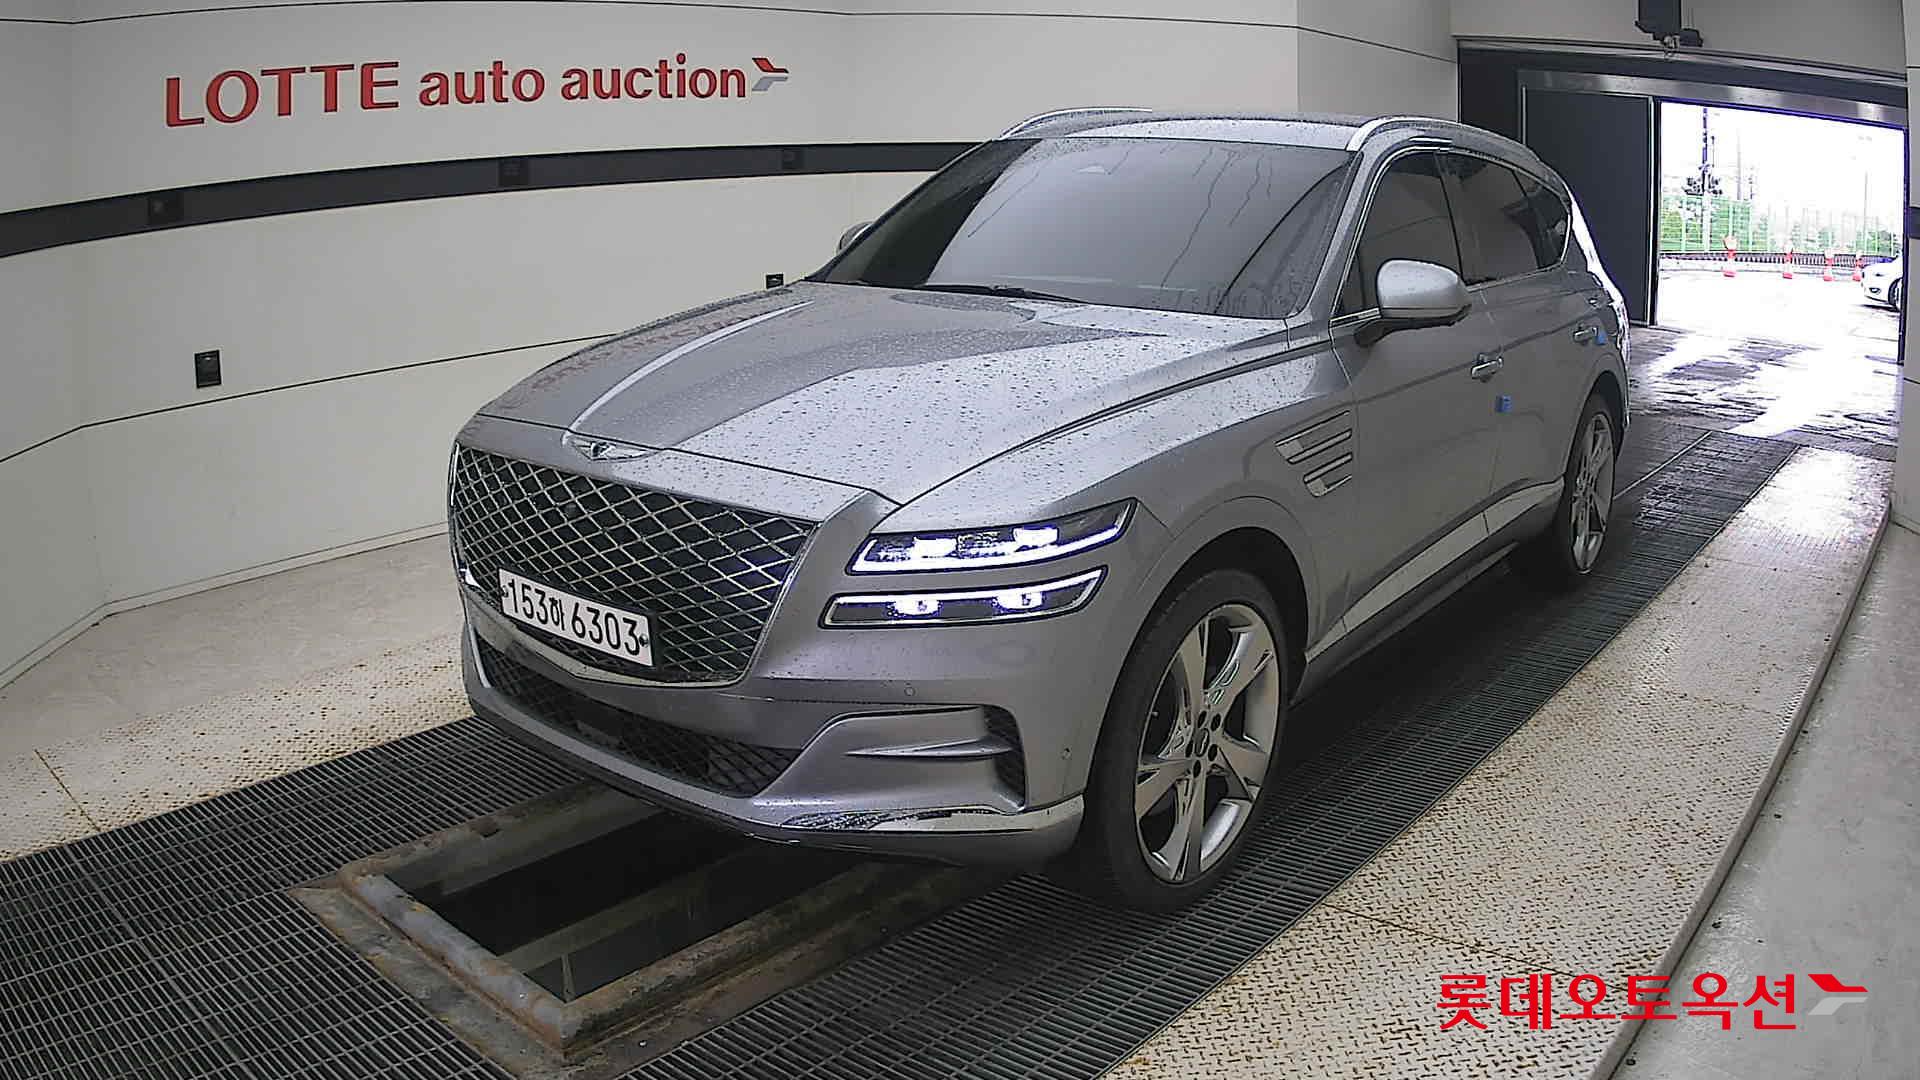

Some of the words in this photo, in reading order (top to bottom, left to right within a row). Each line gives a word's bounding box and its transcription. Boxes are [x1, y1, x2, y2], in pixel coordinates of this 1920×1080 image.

[166, 61, 399, 127] LOTTE
[419, 60, 545, 106] auto
[560, 53, 747, 101] auction
